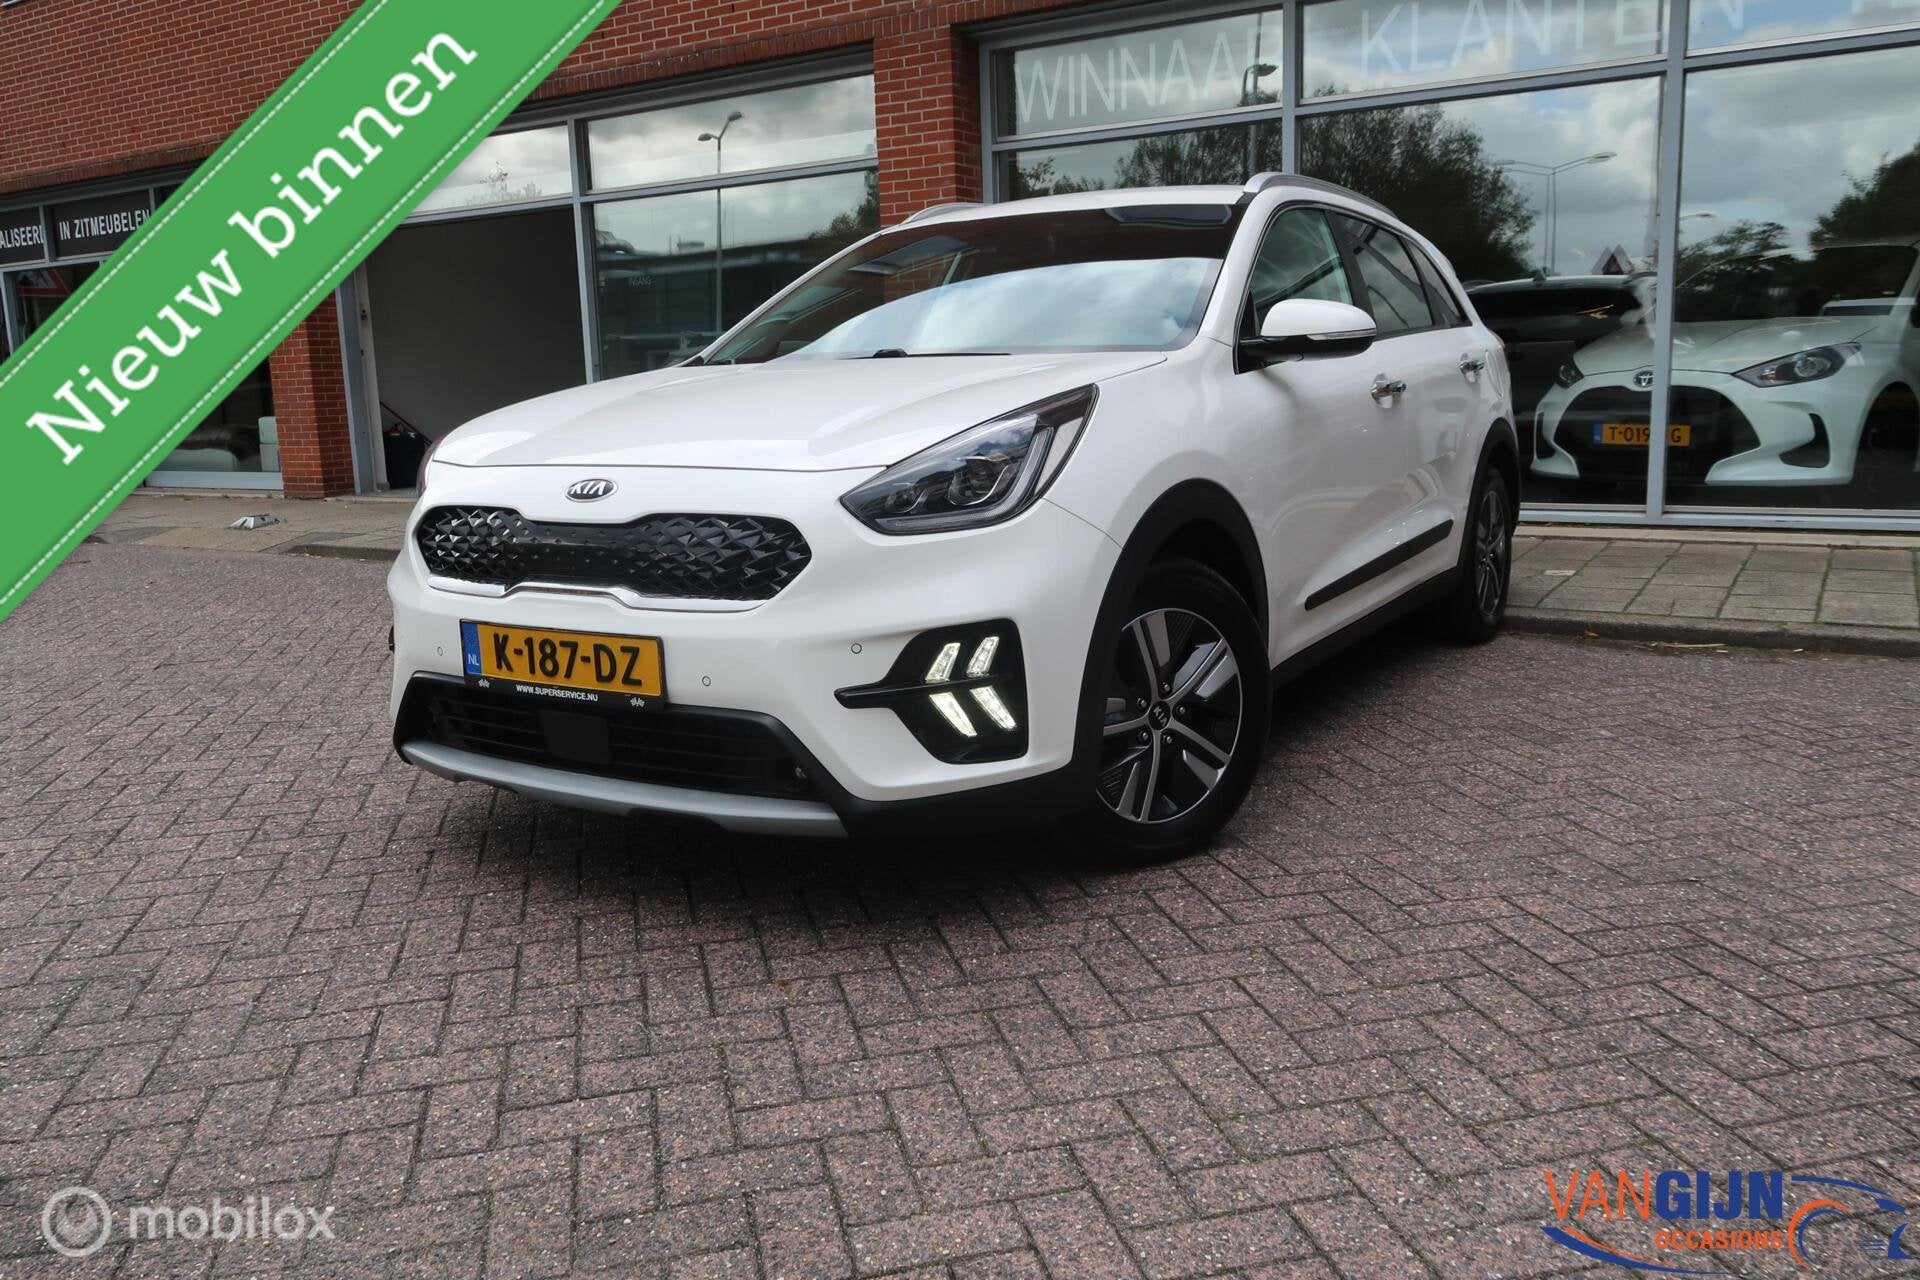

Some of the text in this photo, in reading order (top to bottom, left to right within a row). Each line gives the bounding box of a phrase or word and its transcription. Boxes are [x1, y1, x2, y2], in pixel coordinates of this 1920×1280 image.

[59, 221, 71, 240] IN
[570, 481, 607, 495] KIA
[468, 653, 479, 666] NL
[493, 633, 642, 687] K-187-DZ
[516, 684, 598, 702] WWW.SUPERSERVICE.NU
